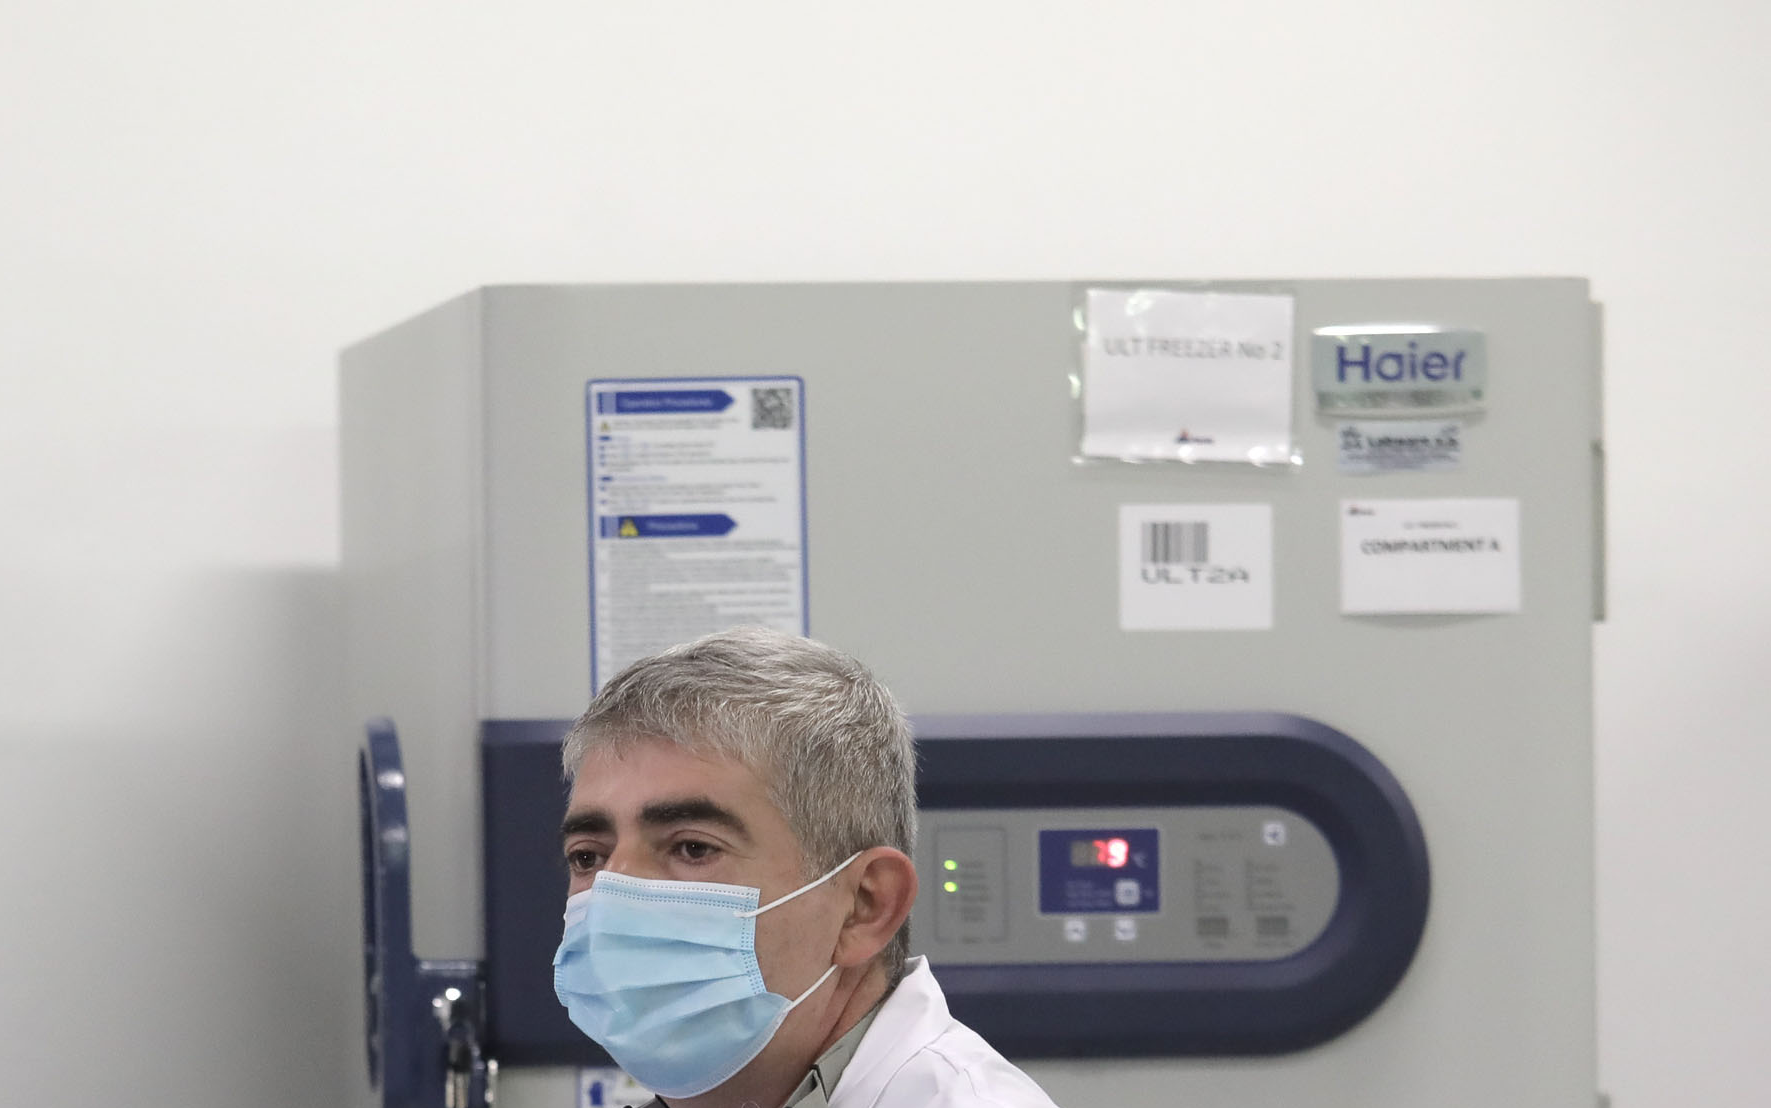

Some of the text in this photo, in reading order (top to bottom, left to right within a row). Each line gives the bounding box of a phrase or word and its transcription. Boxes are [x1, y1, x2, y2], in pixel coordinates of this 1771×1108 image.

[1103, 335, 1144, 358] ULT
[1145, 336, 1233, 360] FREEZER
[1269, 340, 1285, 361] 2
[1335, 342, 1468, 384] Haier
[1361, 539, 1501, 555] COMPARTMENT A
[1140, 566, 1250, 585] ULT2A
